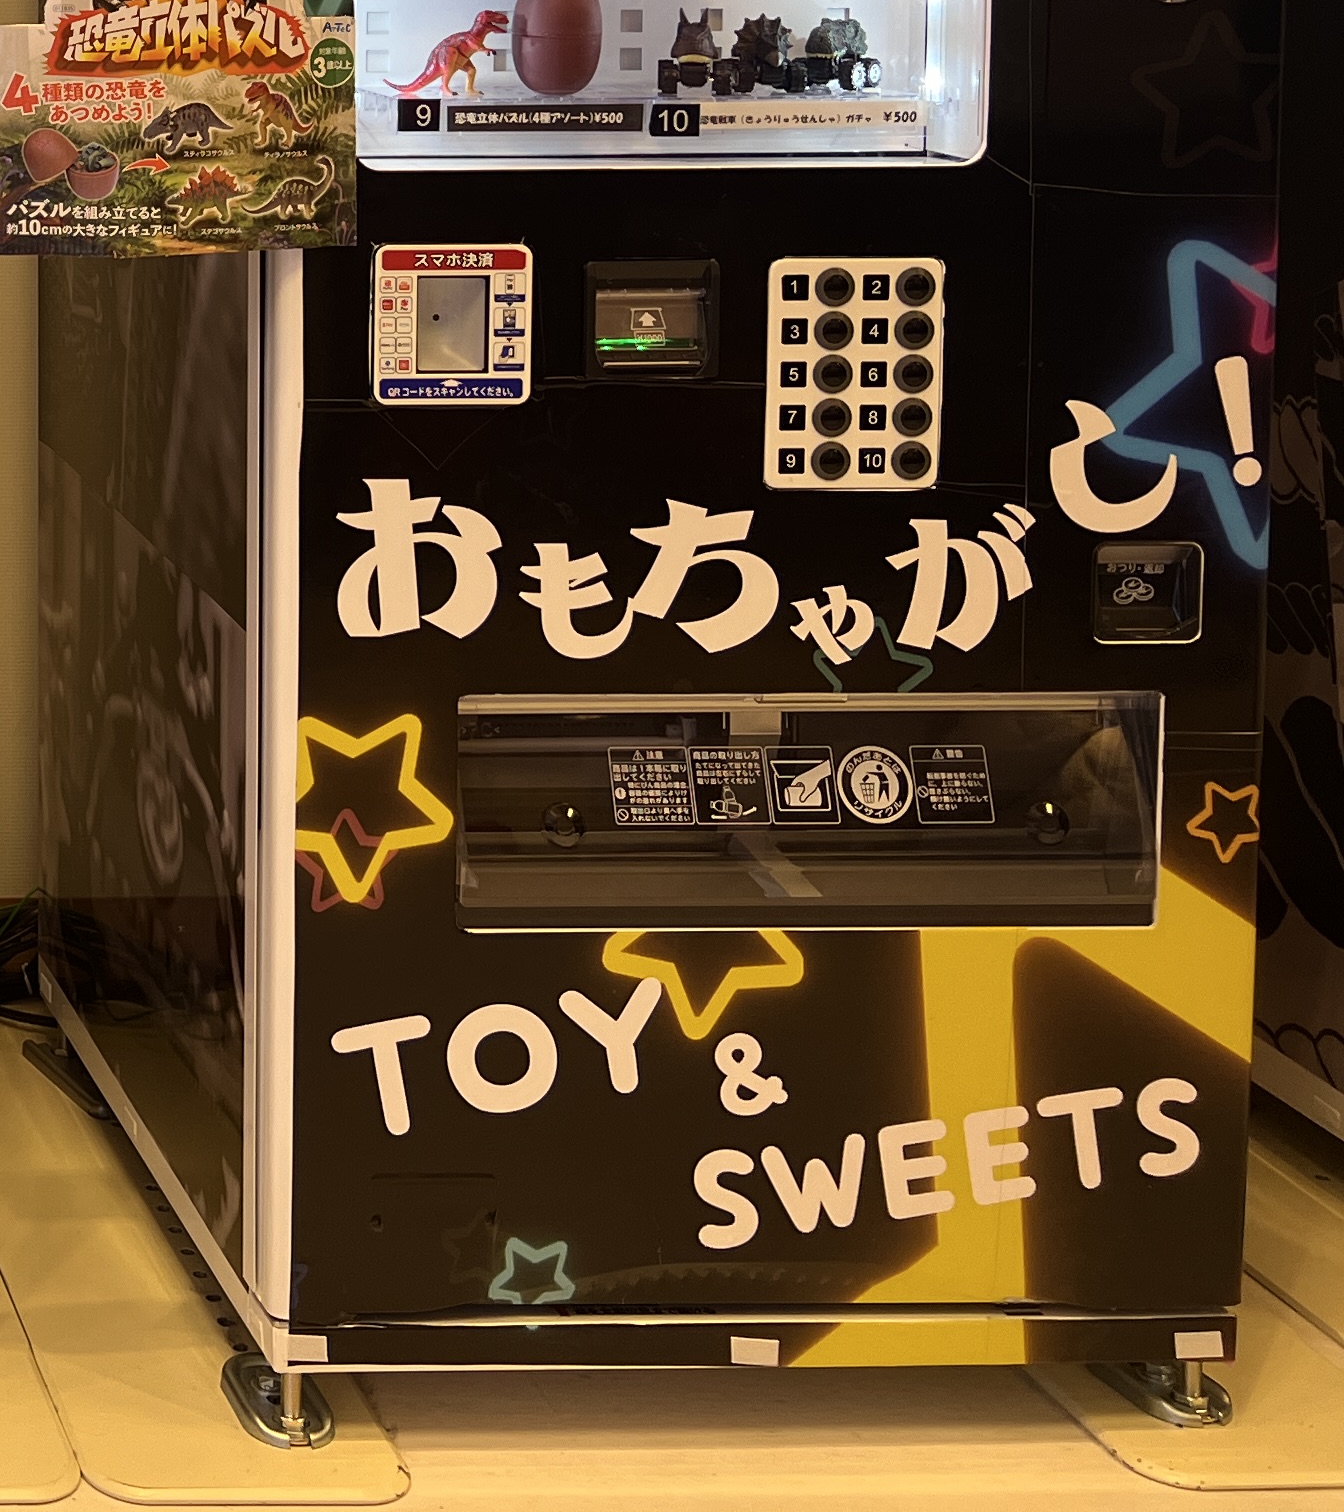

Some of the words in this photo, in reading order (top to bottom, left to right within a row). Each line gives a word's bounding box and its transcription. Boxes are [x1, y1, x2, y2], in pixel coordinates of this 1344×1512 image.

[313, 58, 353, 78] 3歳以上
[50, 104, 154, 124] あつめよう!
[416, 104, 431, 127] 9
[658, 109, 689, 132] 10
[883, 111, 917, 123] ¥500
[6, 199, 162, 220] パズルを組み立てると
[6, 220, 177, 237] 約10cmの大きなフィギュアに!
[413, 251, 495, 270] スマホ決済
[335, 354, 1265, 667] おもちゃがし!
[854, 800, 903, 818] リサイクル
[331, 976, 663, 1136] TOY
[714, 1032, 789, 1117] &
[692, 1076, 1202, 1251] SWEETS
